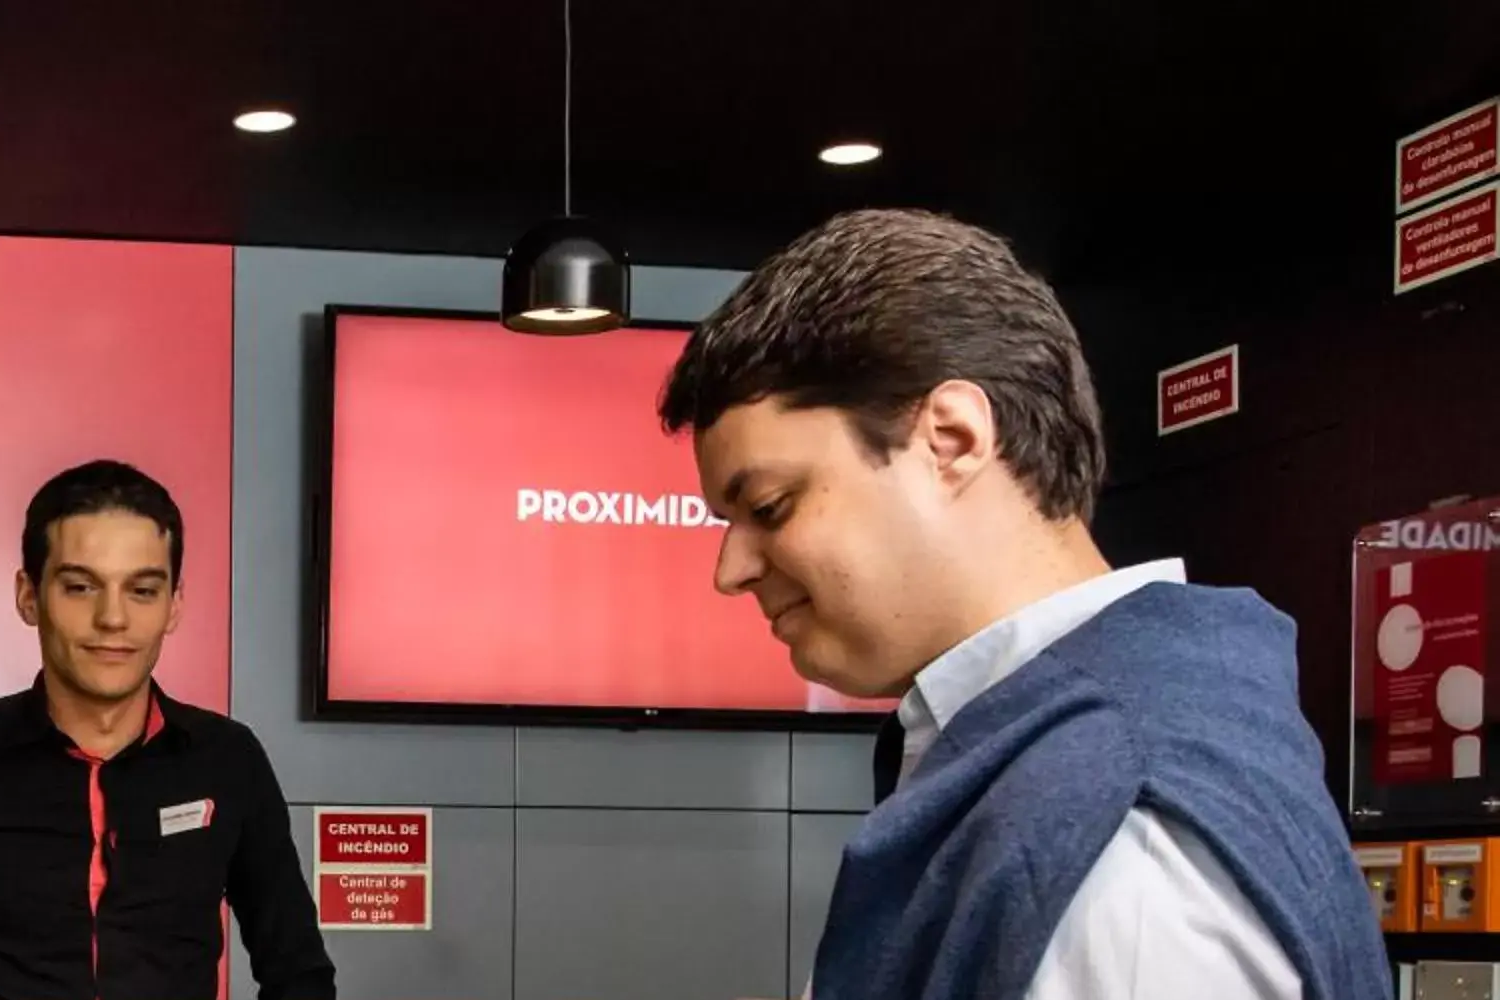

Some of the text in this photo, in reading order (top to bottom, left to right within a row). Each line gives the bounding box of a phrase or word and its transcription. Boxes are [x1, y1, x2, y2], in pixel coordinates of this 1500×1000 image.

[1452, 112, 1493, 141] manual
[1402, 181, 1415, 195] de
[1452, 197, 1492, 224] manual
[1416, 222, 1479, 254] ventiladores
[1401, 233, 1495, 275] de desenfumagem
[1167, 366, 1228, 397] CENTRAL DE
[328, 823, 419, 836] CENTRAL DE
[338, 840, 409, 854] INCÊNDIO
[339, 875, 406, 889] Central de
[347, 893, 399, 907] deteção
[351, 908, 395, 922] de gás
